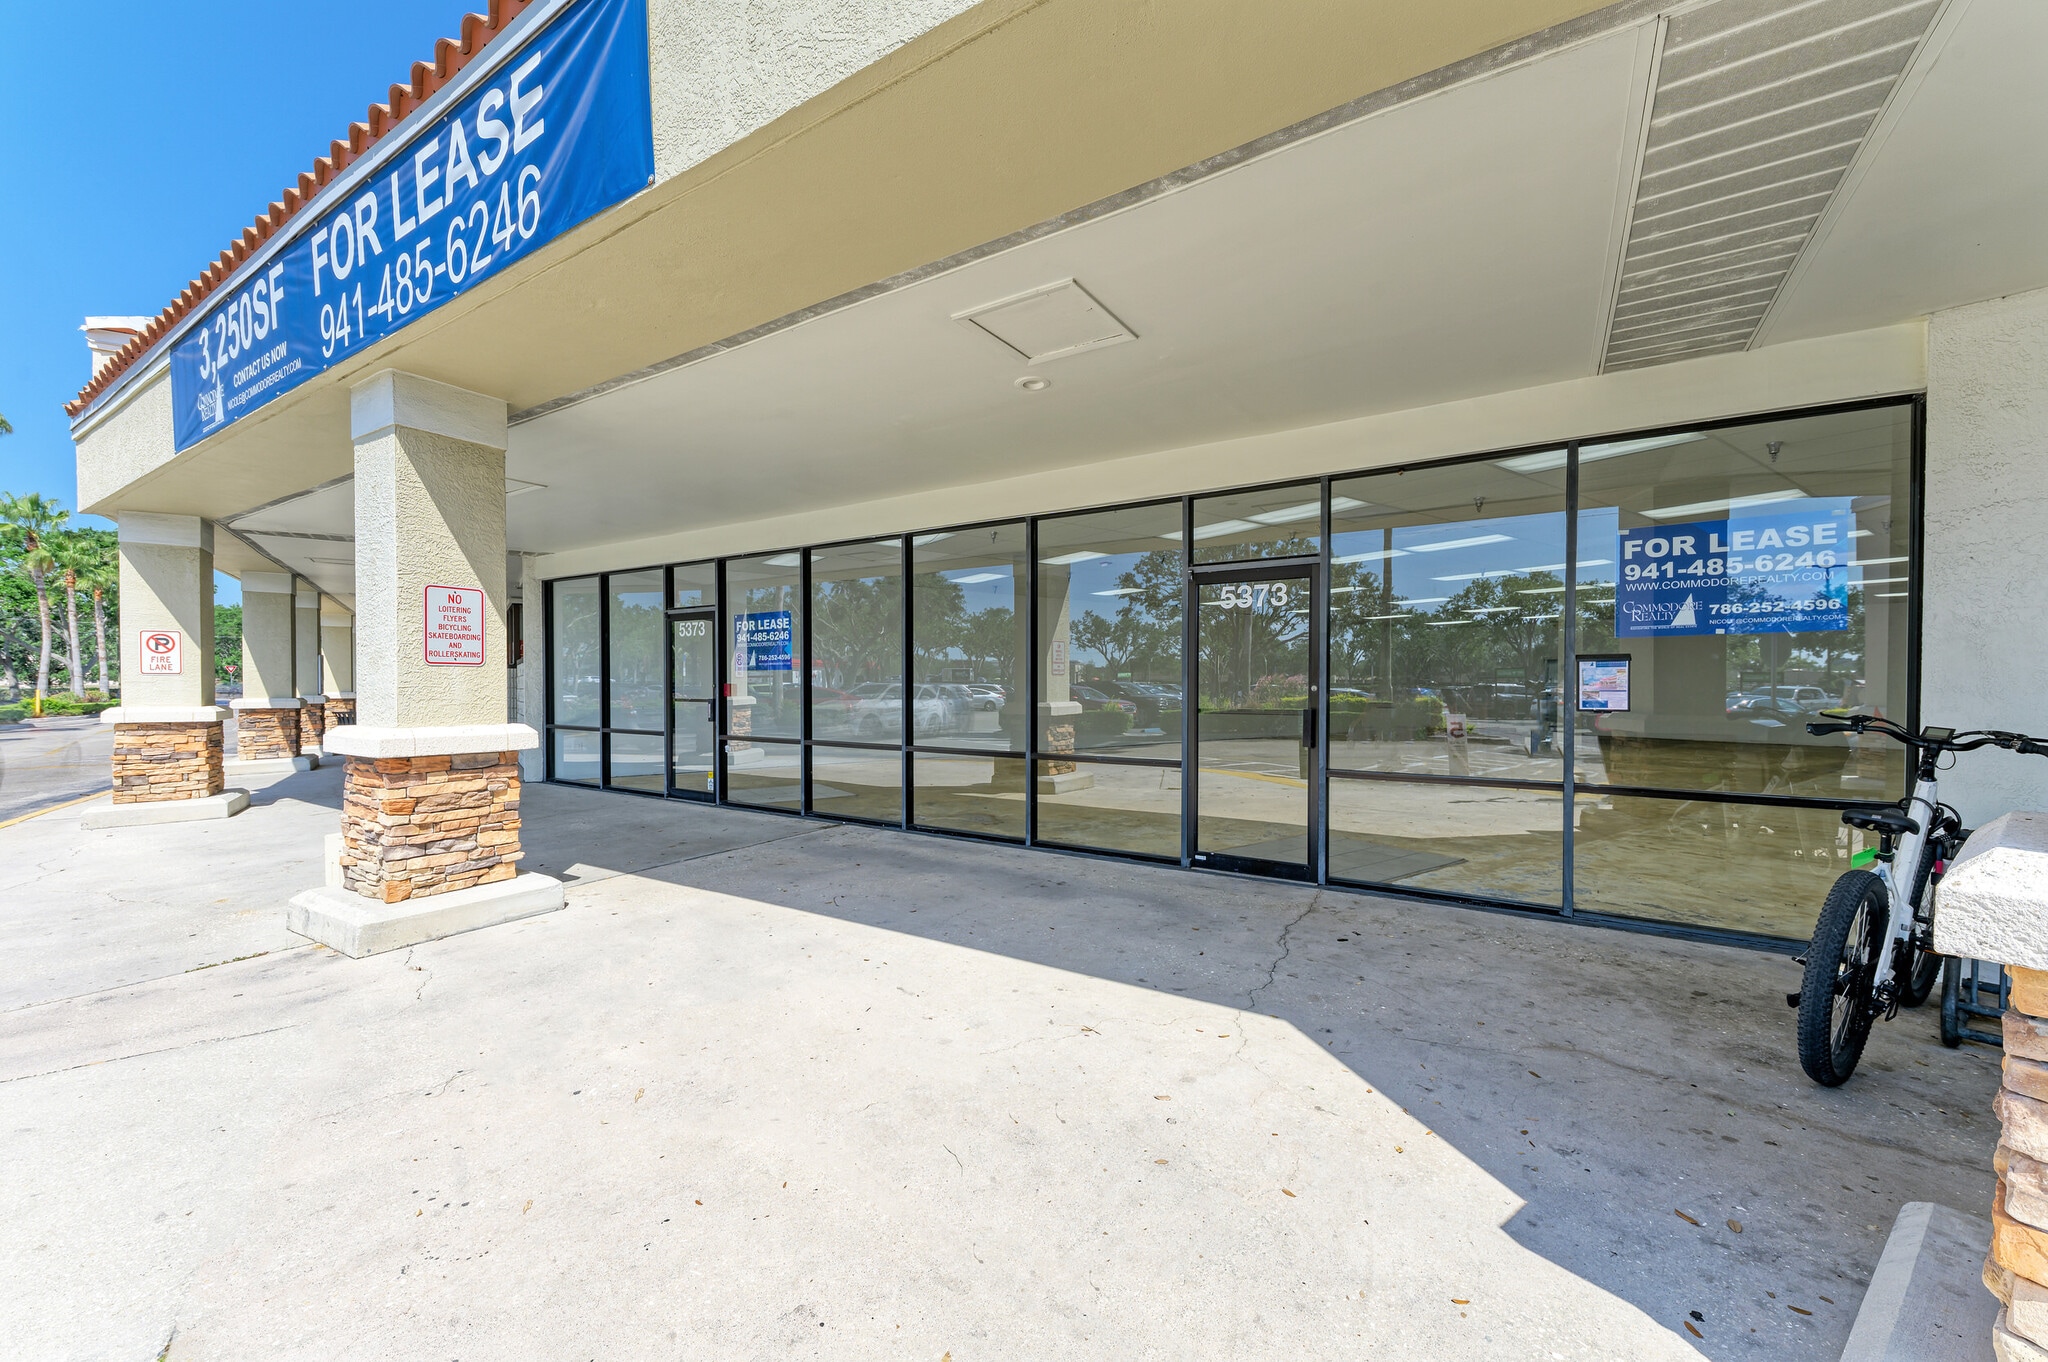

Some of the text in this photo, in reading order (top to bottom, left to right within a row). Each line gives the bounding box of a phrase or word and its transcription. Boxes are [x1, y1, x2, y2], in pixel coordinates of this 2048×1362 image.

[310, 51, 545, 297] FOR LEASE
[320, 164, 542, 358] 941-485-6246
[199, 262, 286, 384] 3,250SF
[233, 341, 287, 388] CONTACT US NOW
[1624, 522, 1838, 560] FOR LEASE
[1624, 549, 1837, 581] 941-485-6246
[1625, 571, 1835, 592] WWW.COMMODOREREALTY.COM
[447, 593, 462, 605] NO
[1220, 582, 1288, 609] 5373
[438, 605, 472, 614] LOITERING
[1622, 600, 1703, 614] COMMODORE
[1708, 598, 1841, 615] 786-252-4596
[443, 614, 467, 623] FLYERS
[1631, 609, 1676, 622] REALTY
[438, 623, 472, 632] BICYCLING
[679, 621, 706, 637] 5373
[736, 617, 790, 631] FOR LEASE
[428, 631, 481, 641] SKATEBOARDING
[736, 630, 790, 642] 941-485-6246
[448, 641, 462, 649] AND
[151, 656, 172, 664] FIRE
[428, 650, 481, 659] ROLLERSKATING
